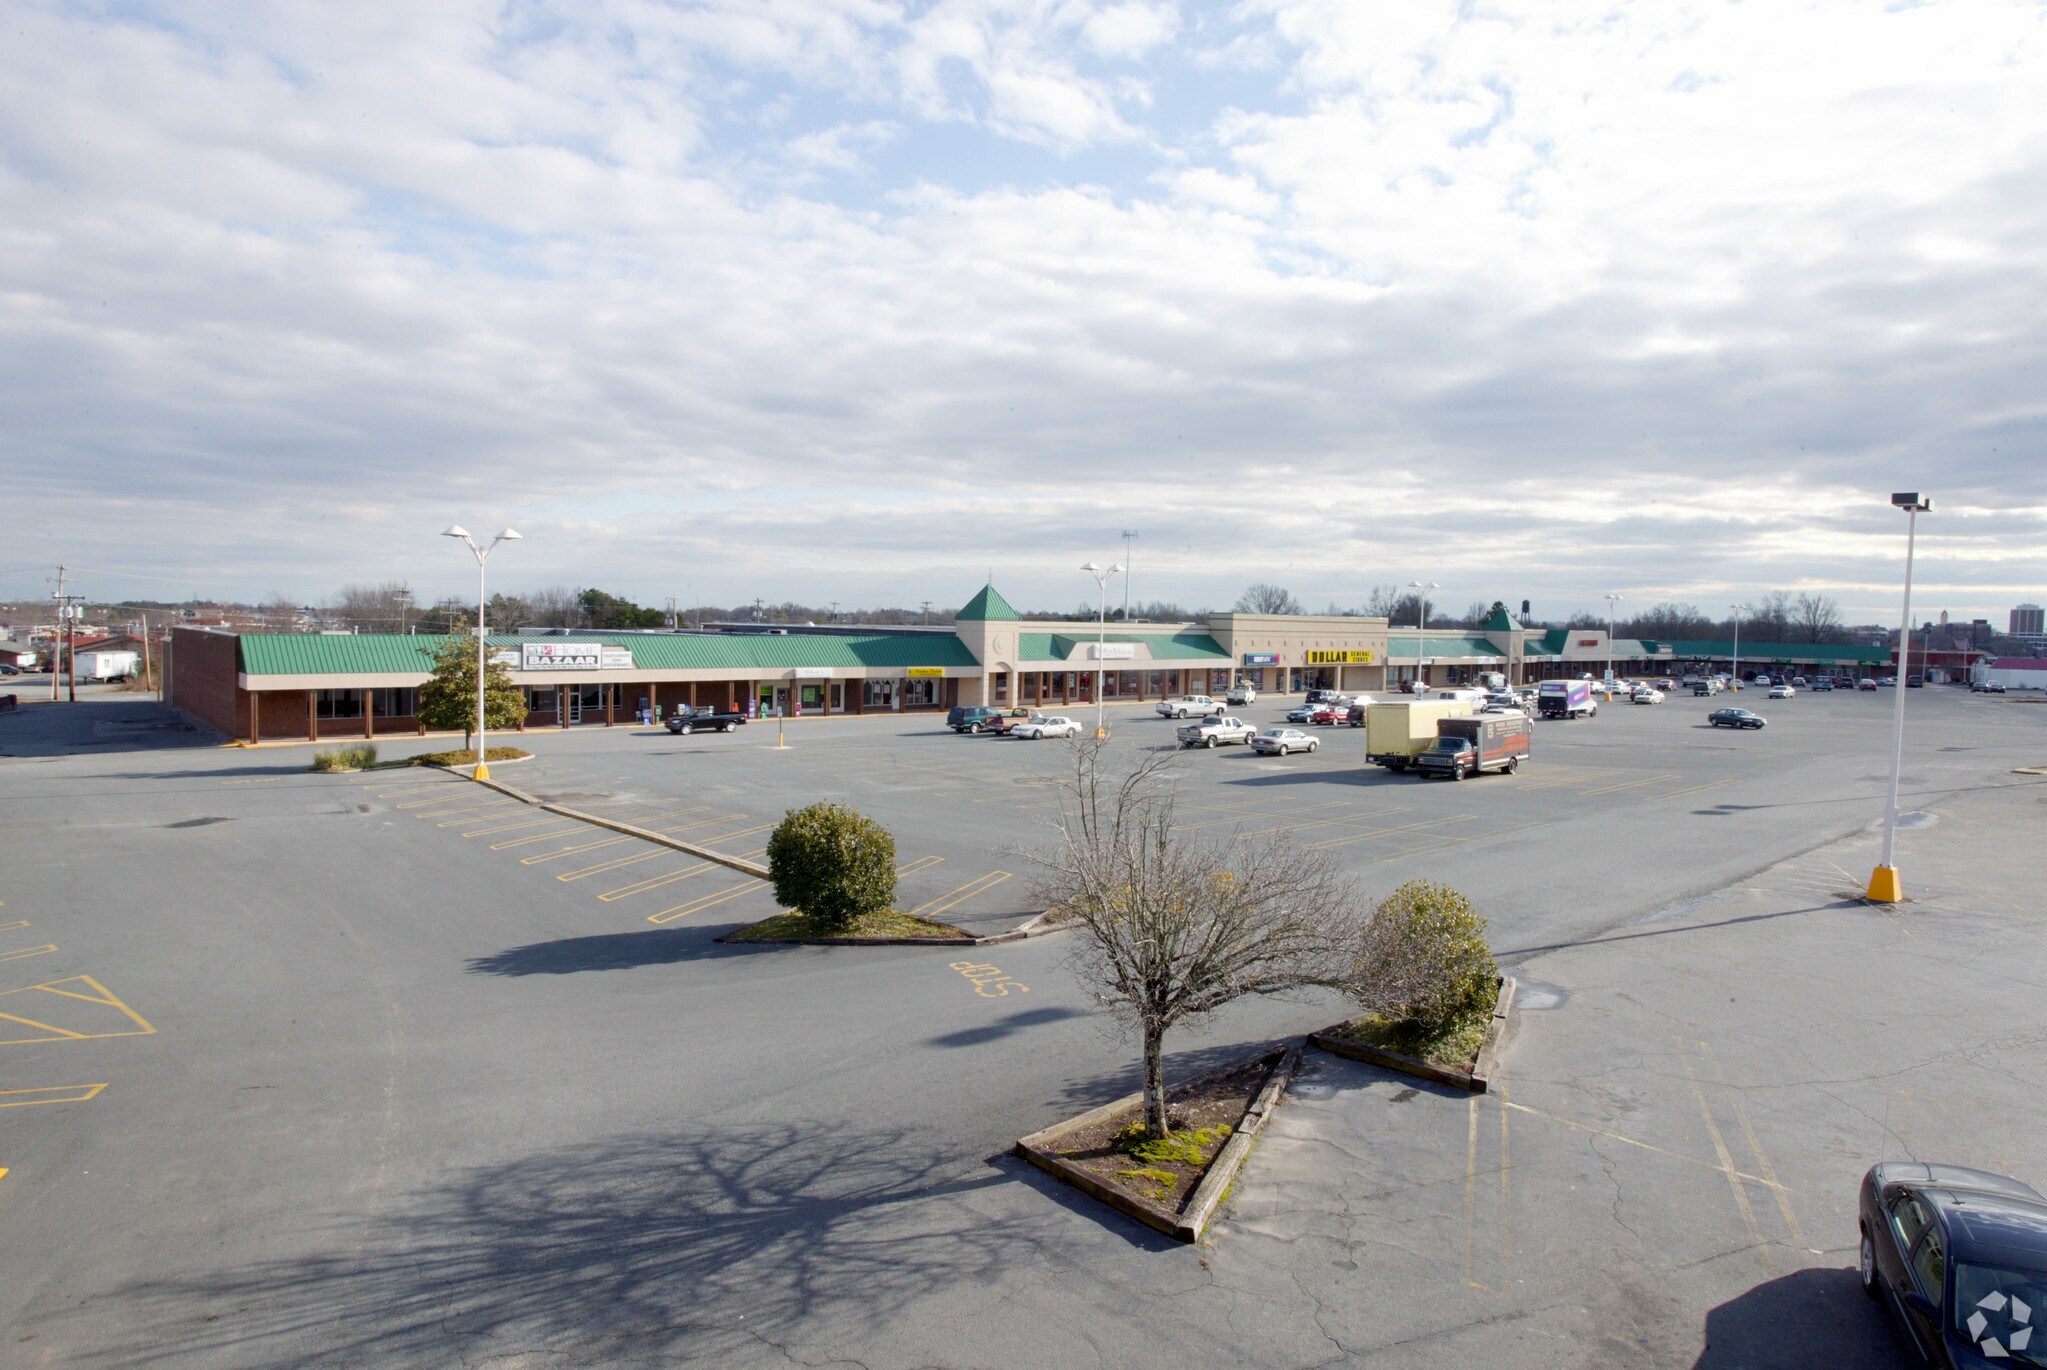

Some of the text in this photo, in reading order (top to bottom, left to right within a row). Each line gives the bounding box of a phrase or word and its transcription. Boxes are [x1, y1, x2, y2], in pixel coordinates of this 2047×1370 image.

[554, 644, 595, 656] HOME
[528, 656, 597, 665] BAZAAR
[1312, 651, 1348, 663] DOLLAR
